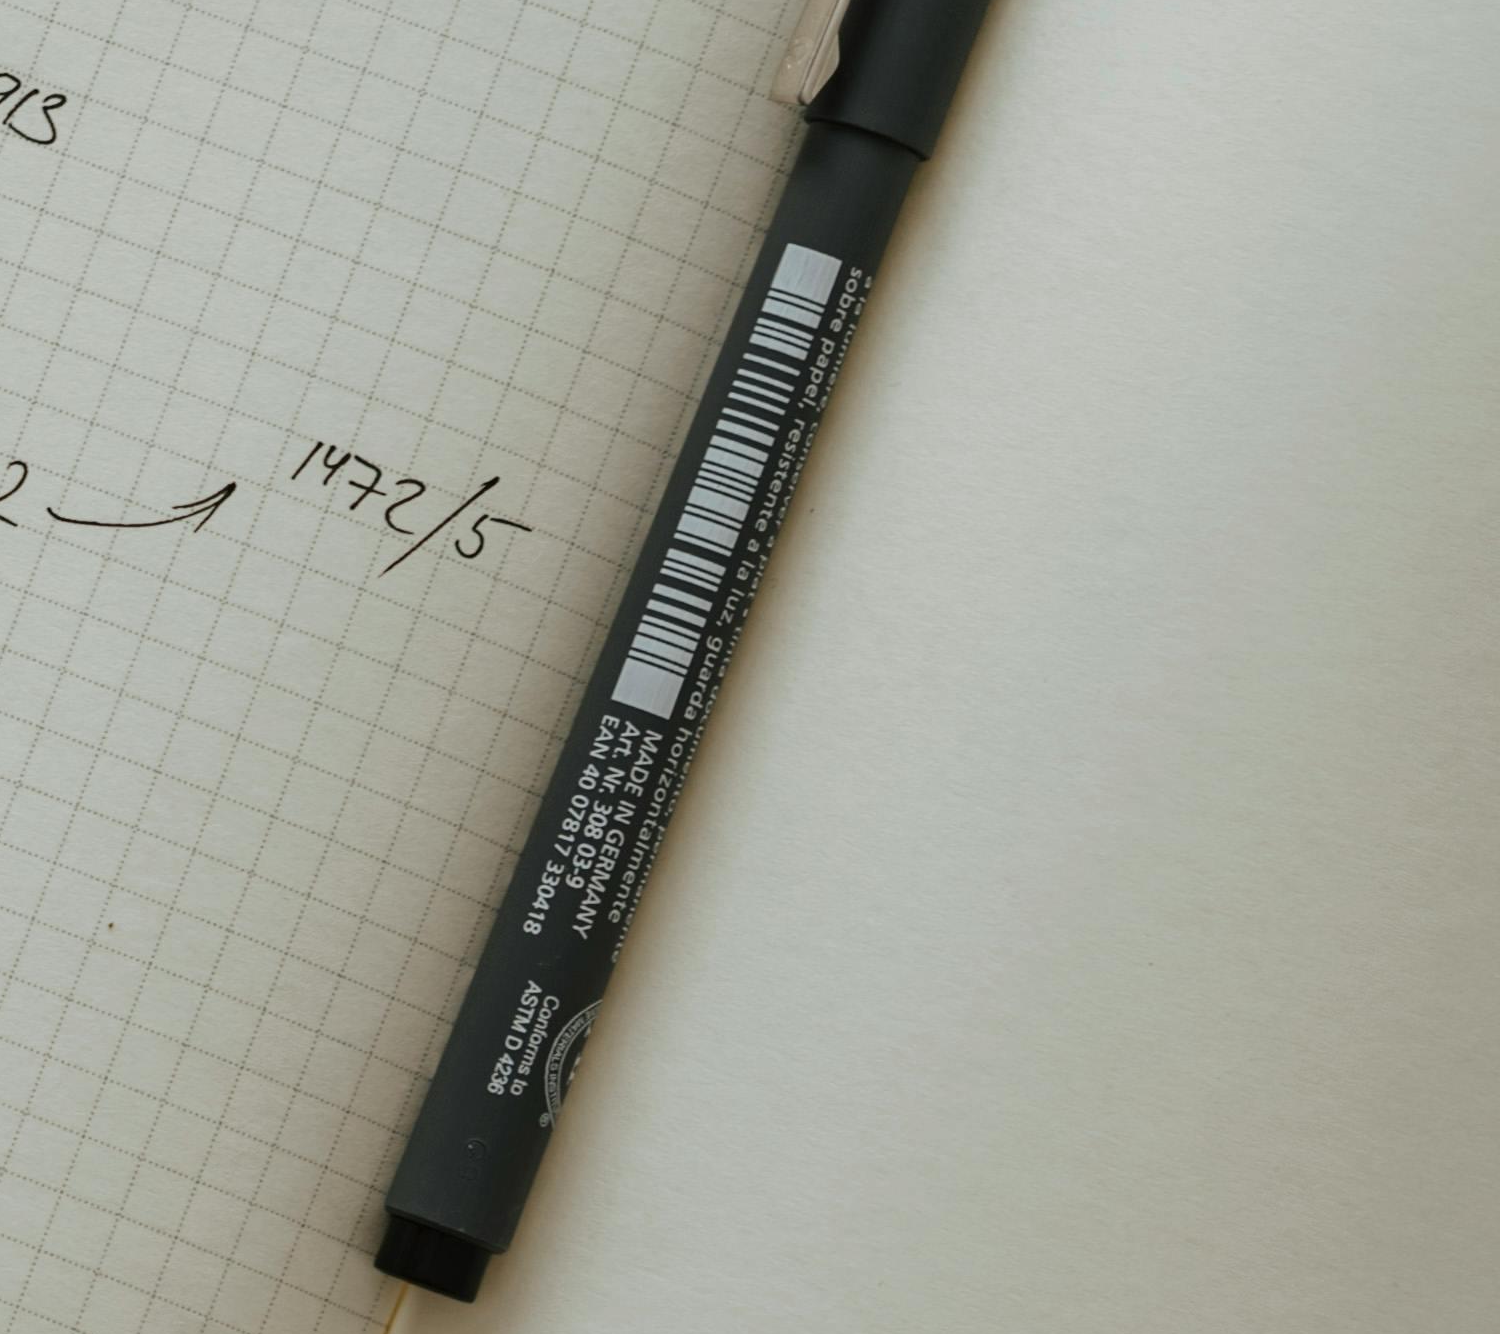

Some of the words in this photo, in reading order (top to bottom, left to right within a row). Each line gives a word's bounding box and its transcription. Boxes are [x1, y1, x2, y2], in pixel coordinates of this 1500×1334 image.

[828, 265, 866, 334] sobre
[796, 336, 839, 412] papel,
[753, 416, 808, 534] resistente
[745, 537, 761, 553] a
[734, 559, 755, 582] la
[714, 586, 745, 630] luz,
[680, 634, 726, 722] guarda
[588, 712, 620, 760] EAN
[611, 719, 643, 763] Art.
[576, 761, 602, 791] 40
[598, 765, 625, 798] Nr.
[623, 728, 663, 797] MADE
[551, 792, 590, 857] 07817
[582, 799, 613, 841] 308
[606, 726, 693, 926] horizontalmente
[612, 799, 637, 825] IN
[563, 841, 597, 891] 03-9
[569, 826, 627, 939] GERMANY
[521, 859, 565, 936] 330418
[510, 979, 543, 1034] ASTM
[503, 1034, 523, 1052] D
[516, 993, 561, 1077] Conforms
[486, 1051, 516, 1096] 4236
[509, 1077, 528, 1097] to
